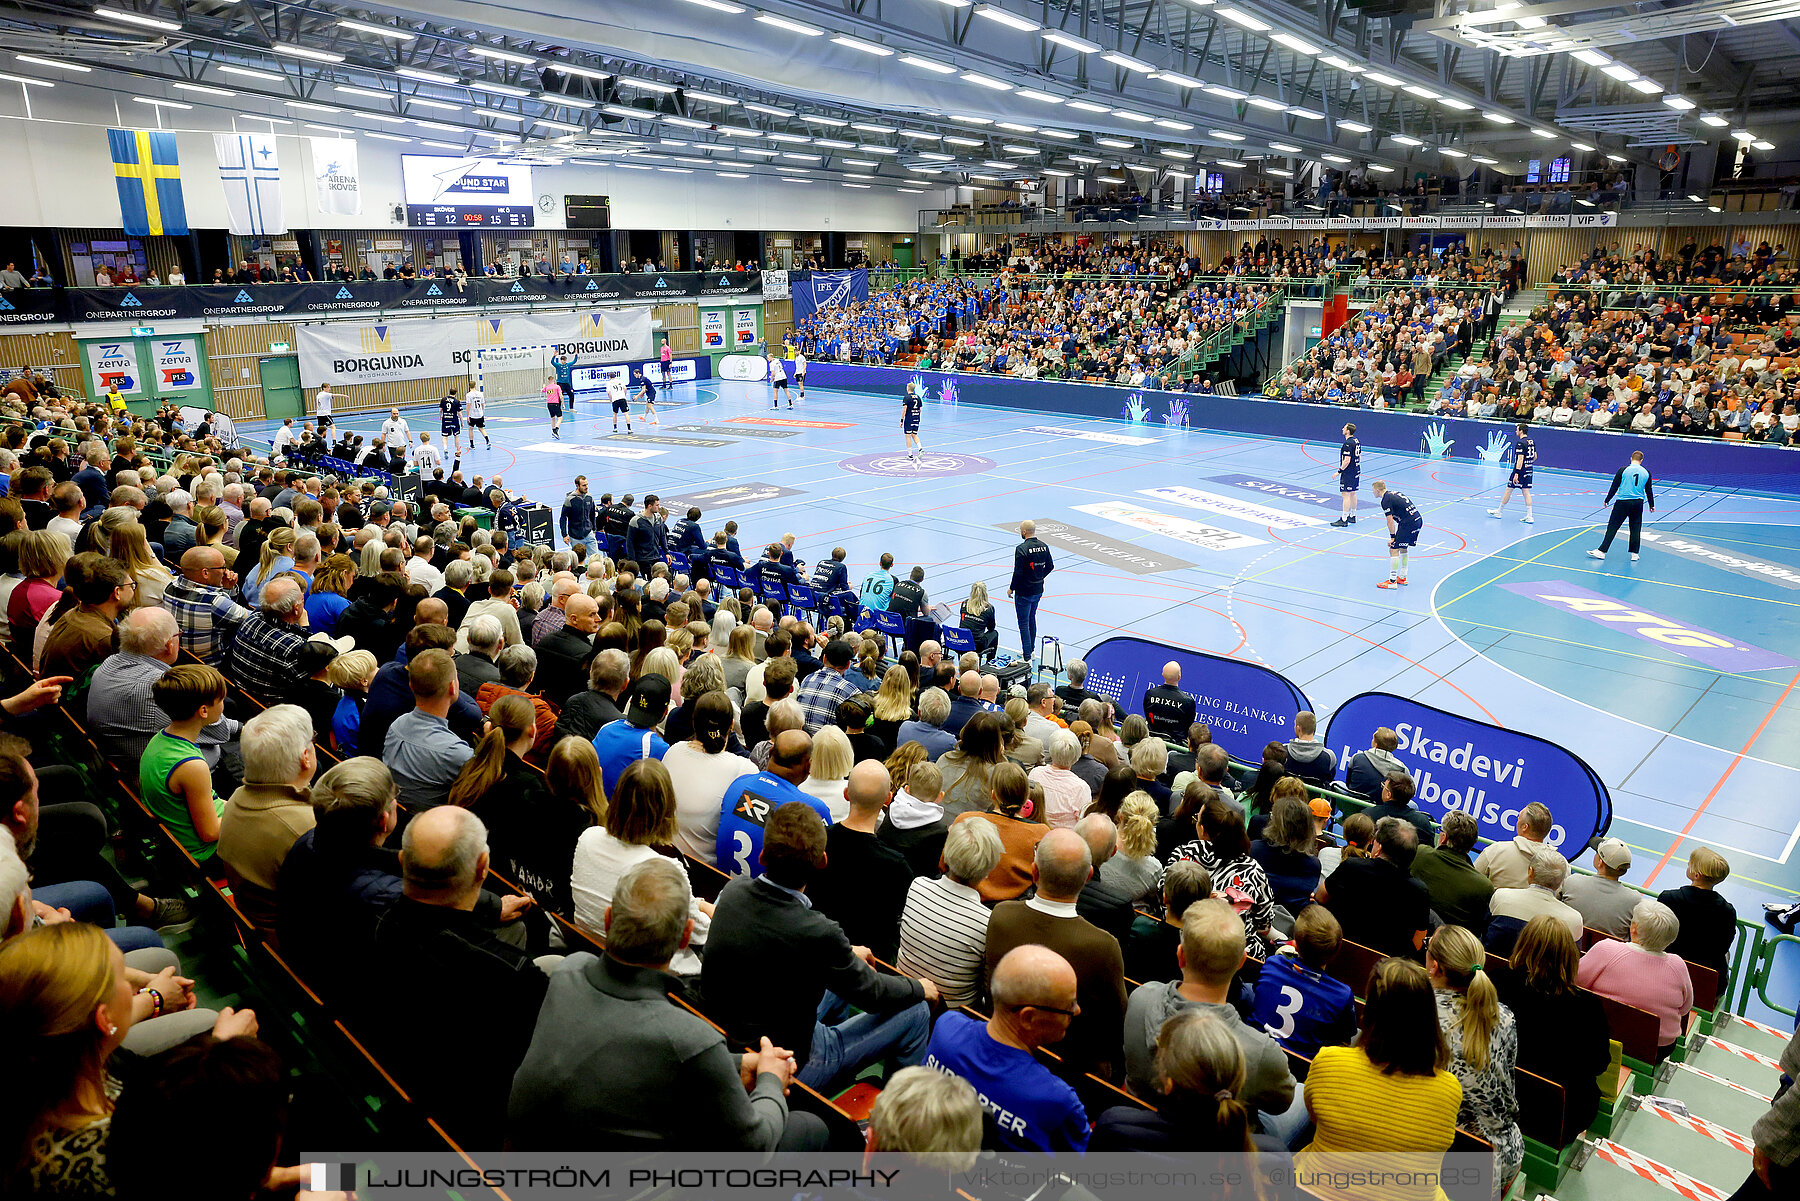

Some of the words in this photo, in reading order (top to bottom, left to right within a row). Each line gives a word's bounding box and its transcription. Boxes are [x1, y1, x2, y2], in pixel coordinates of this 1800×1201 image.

[482, 179, 506, 188] STAR
[445, 215, 457, 224] 12
[463, 214, 483, 222] 00:58
[490, 216, 501, 225] 15
[1577, 216, 1595, 224] VIP
[817, 283, 833, 292] IFK
[402, 298, 467, 306] ONEPARTNERGROUP
[488, 294, 547, 302] ONEPARTNERGROUP
[204, 305, 284, 315] ONEPARTNERGROUP
[308, 302, 380, 310] ONEPARTNERGROUP
[86, 309, 177, 319] ONEPARTNERGROUP
[558, 339, 629, 356] BORGUNDA
[97, 359, 130, 369] zerva
[160, 356, 192, 365] zerva
[334, 354, 424, 374] BORGUNDA
[172, 373, 186, 381] PLS
[446, 403, 452, 411] 9
[913, 400, 918, 409] 2
[1526, 446, 1534, 458] 33
[421, 456, 432, 468] 14
[1633, 473, 1639, 487] 1
[532, 530, 545, 540] EY
[1187, 528, 1242, 542] SH
[1051, 532, 1162, 568] BILLINGEHUS
[866, 578, 886, 595] 16
[898, 582, 921, 593] BRIXLY
[1535, 594, 1734, 648] ATG
[639, 694, 648, 708] LA
[1150, 696, 1183, 709] BRIXLY
[1225, 701, 1286, 726] BLANKAS
[1395, 723, 1525, 788] Skadevi
[1264, 986, 1304, 1038] 3
